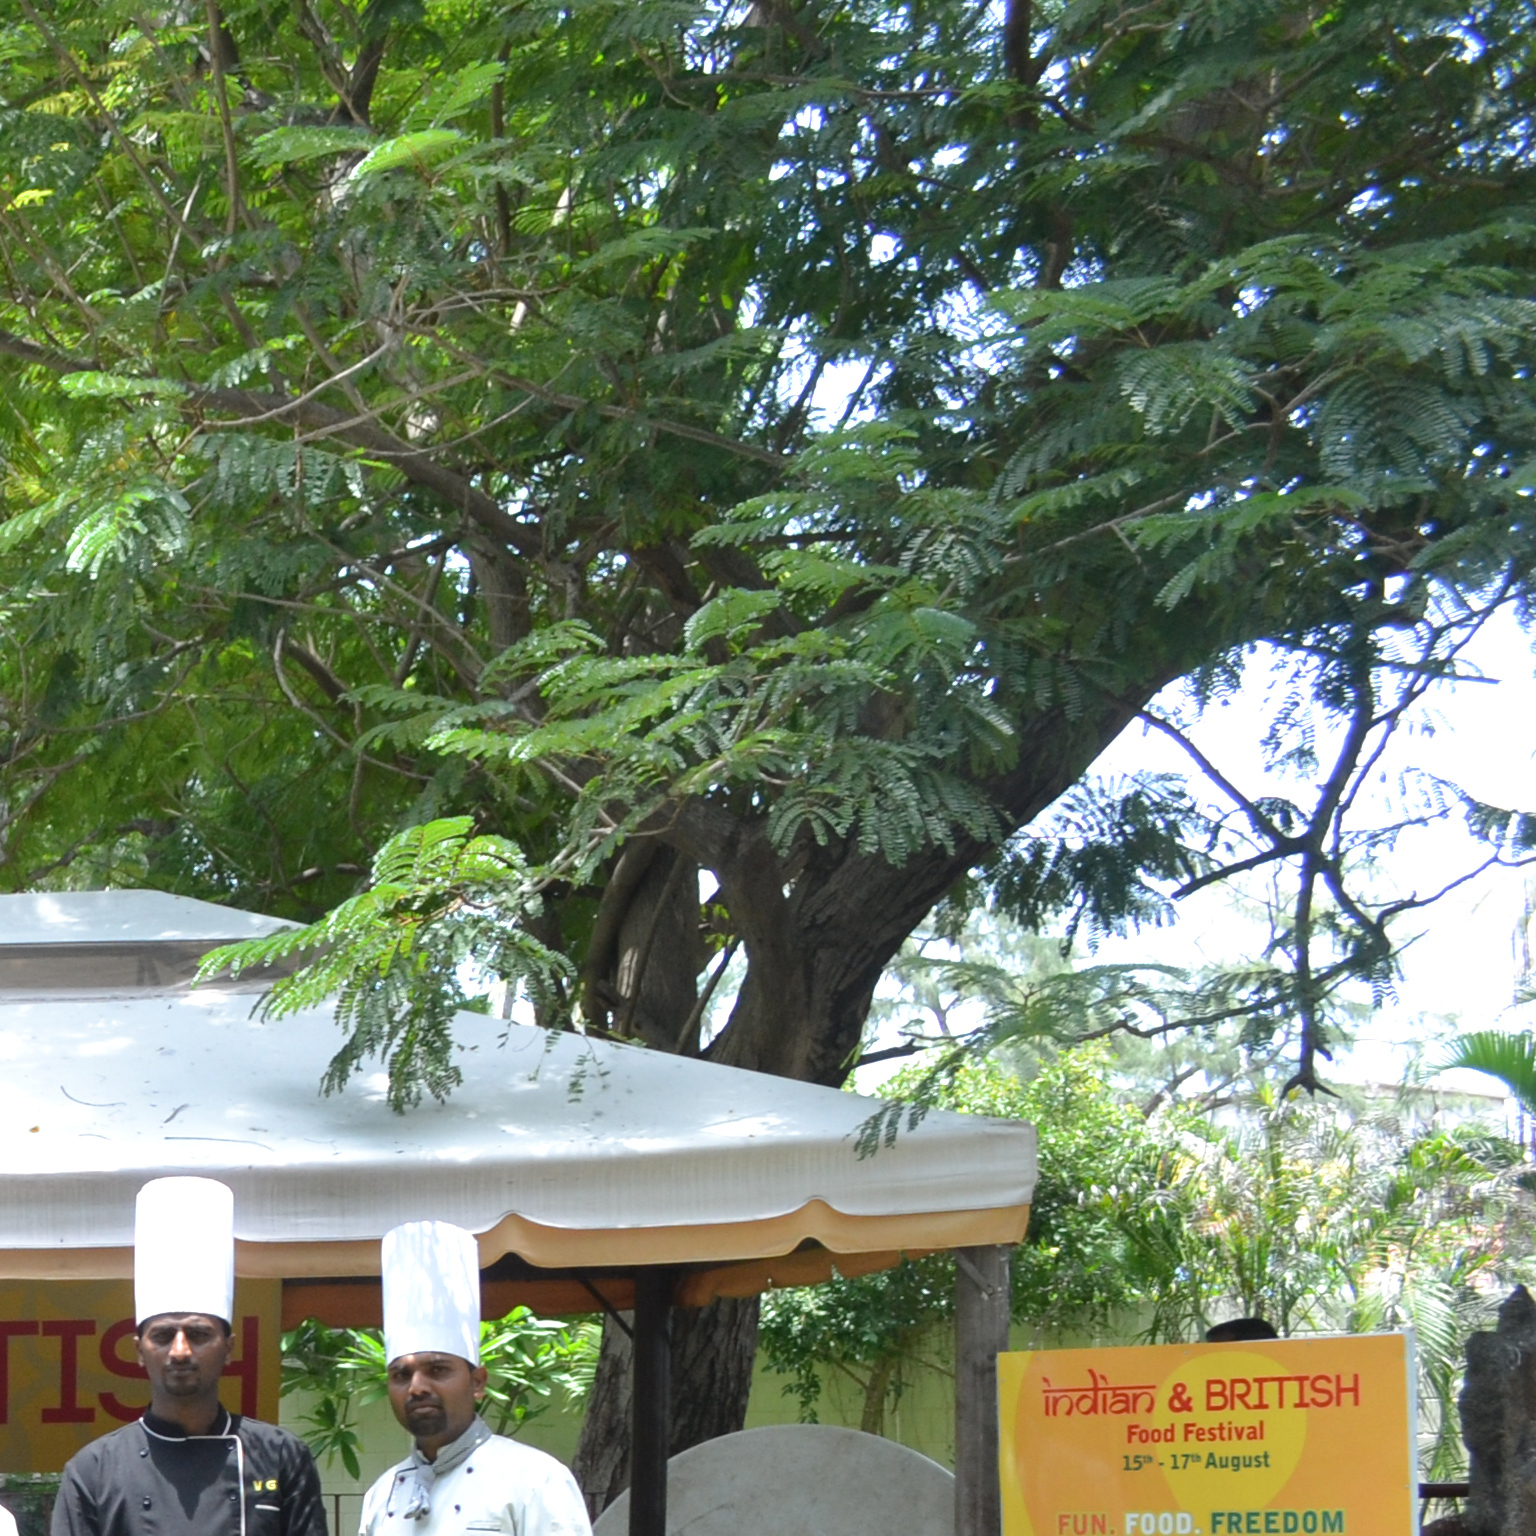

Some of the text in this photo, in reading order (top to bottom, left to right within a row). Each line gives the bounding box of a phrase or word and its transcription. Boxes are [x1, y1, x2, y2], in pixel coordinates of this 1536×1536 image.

[1168, 1383, 1192, 1413] &
[1206, 1373, 1359, 1411] BRITISH
[1128, 1420, 1264, 1444] Food Festival
[1205, 1451, 1269, 1472] August
[1058, 1511, 1344, 1536] FUN. FOOD. FREEDOM
